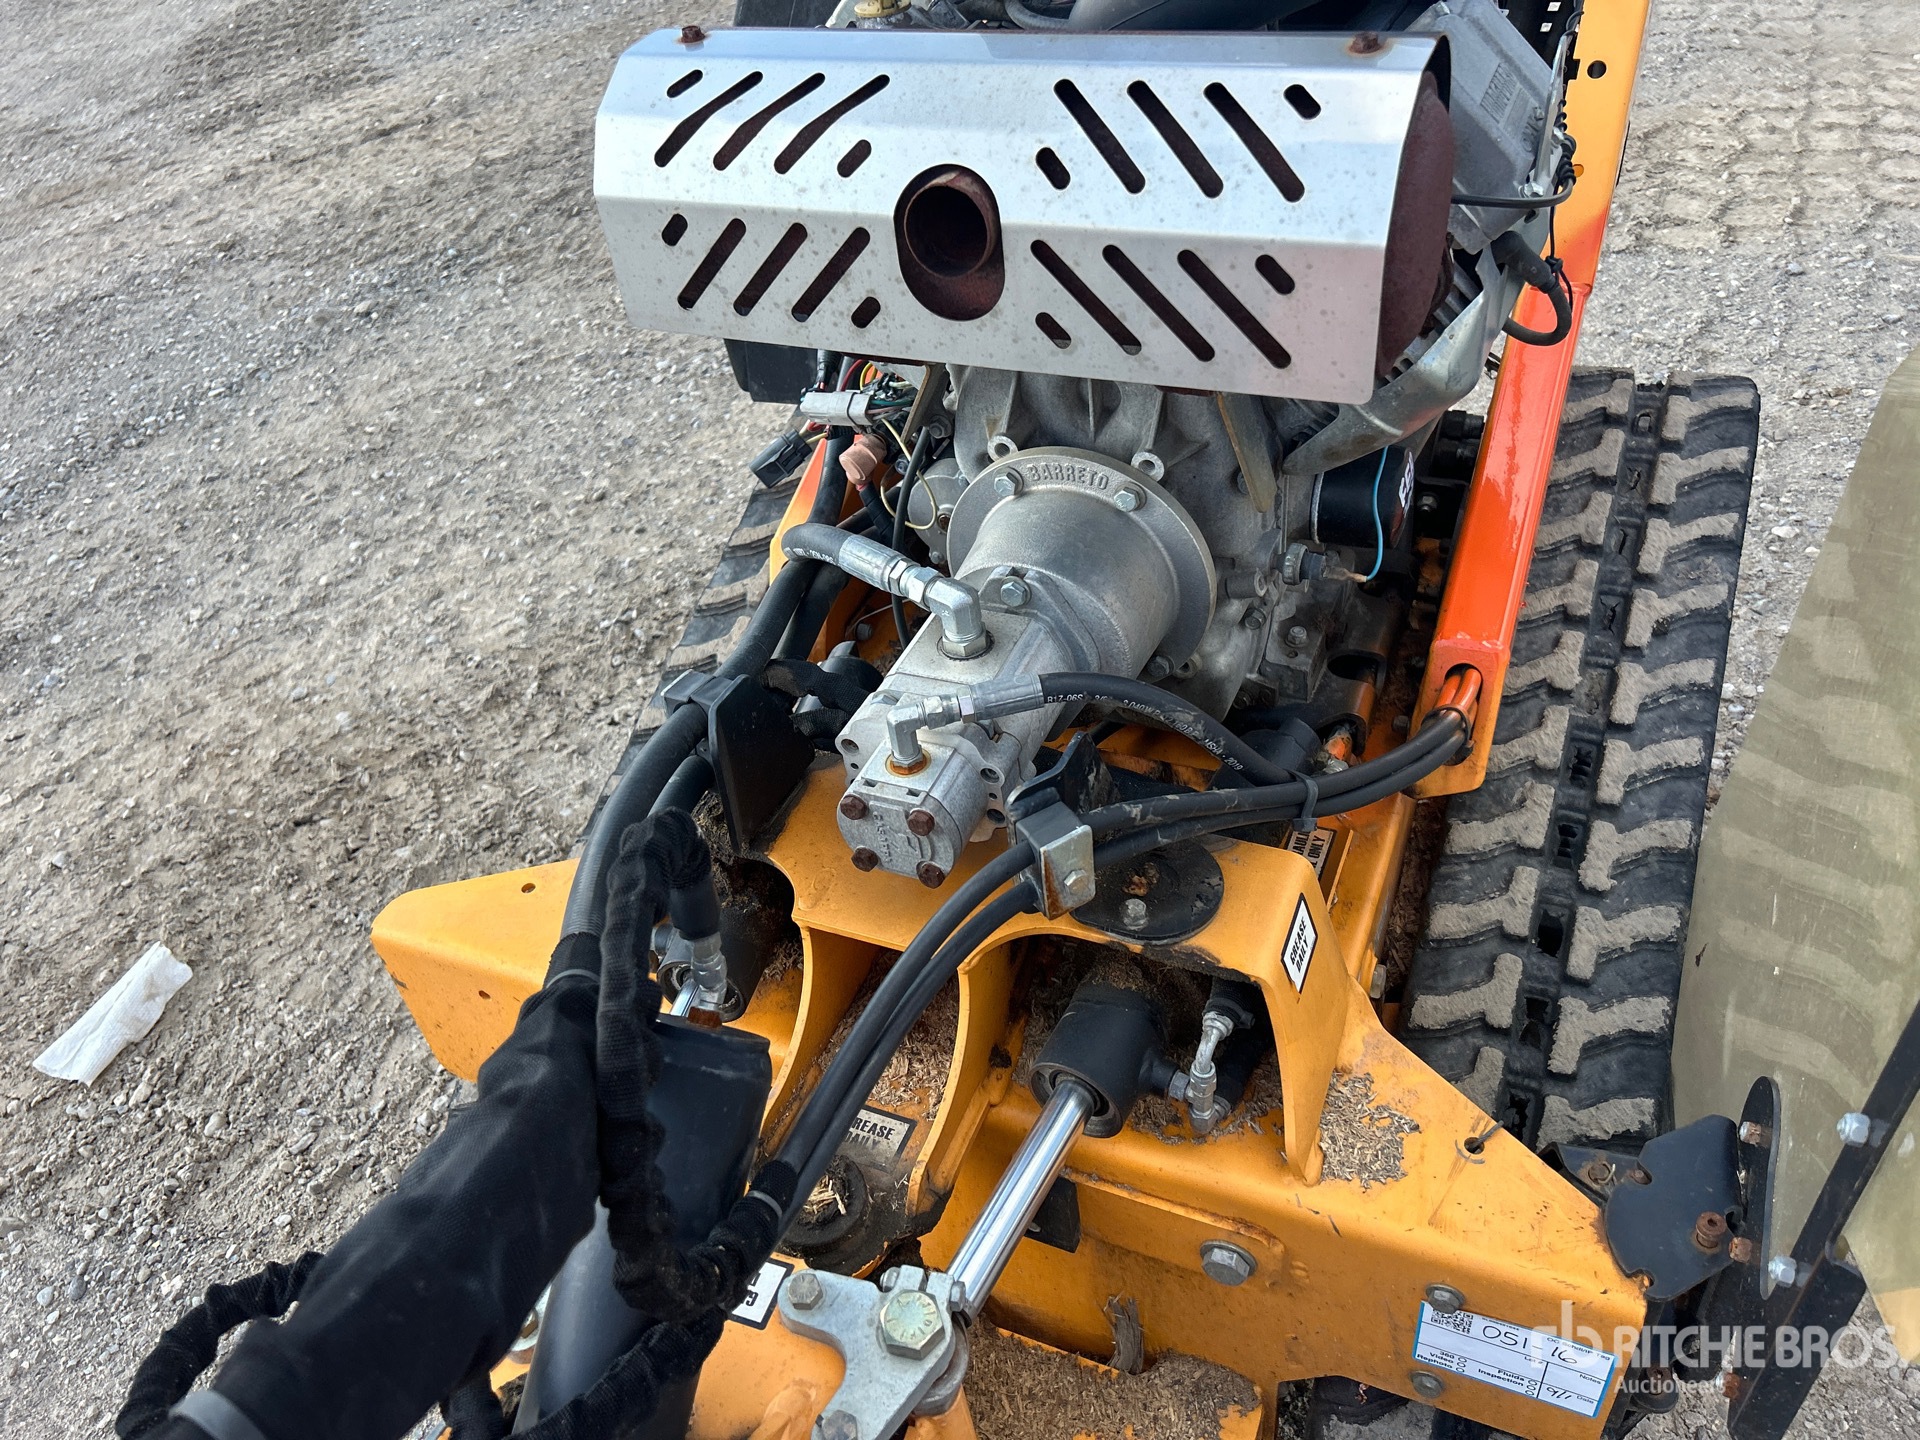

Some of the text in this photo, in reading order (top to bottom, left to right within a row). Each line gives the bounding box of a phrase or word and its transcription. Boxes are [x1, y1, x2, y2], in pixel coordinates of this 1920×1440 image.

[1027, 463, 1109, 490] BARRETO
[1307, 834, 1326, 859] ONLY
[1290, 917, 1308, 966] GREASE
[1296, 935, 1310, 973] DAILY
[852, 1118, 896, 1141] REASE
[1416, 1353, 1453, 1369] Rephoto
[1430, 1352, 1454, 1364] Video
[1440, 1351, 1455, 1359] 360
[1478, 1368, 1524, 1387] Inspection
[1497, 1369, 1525, 1382] Fluids
[1580, 1373, 1601, 1385] Notes
